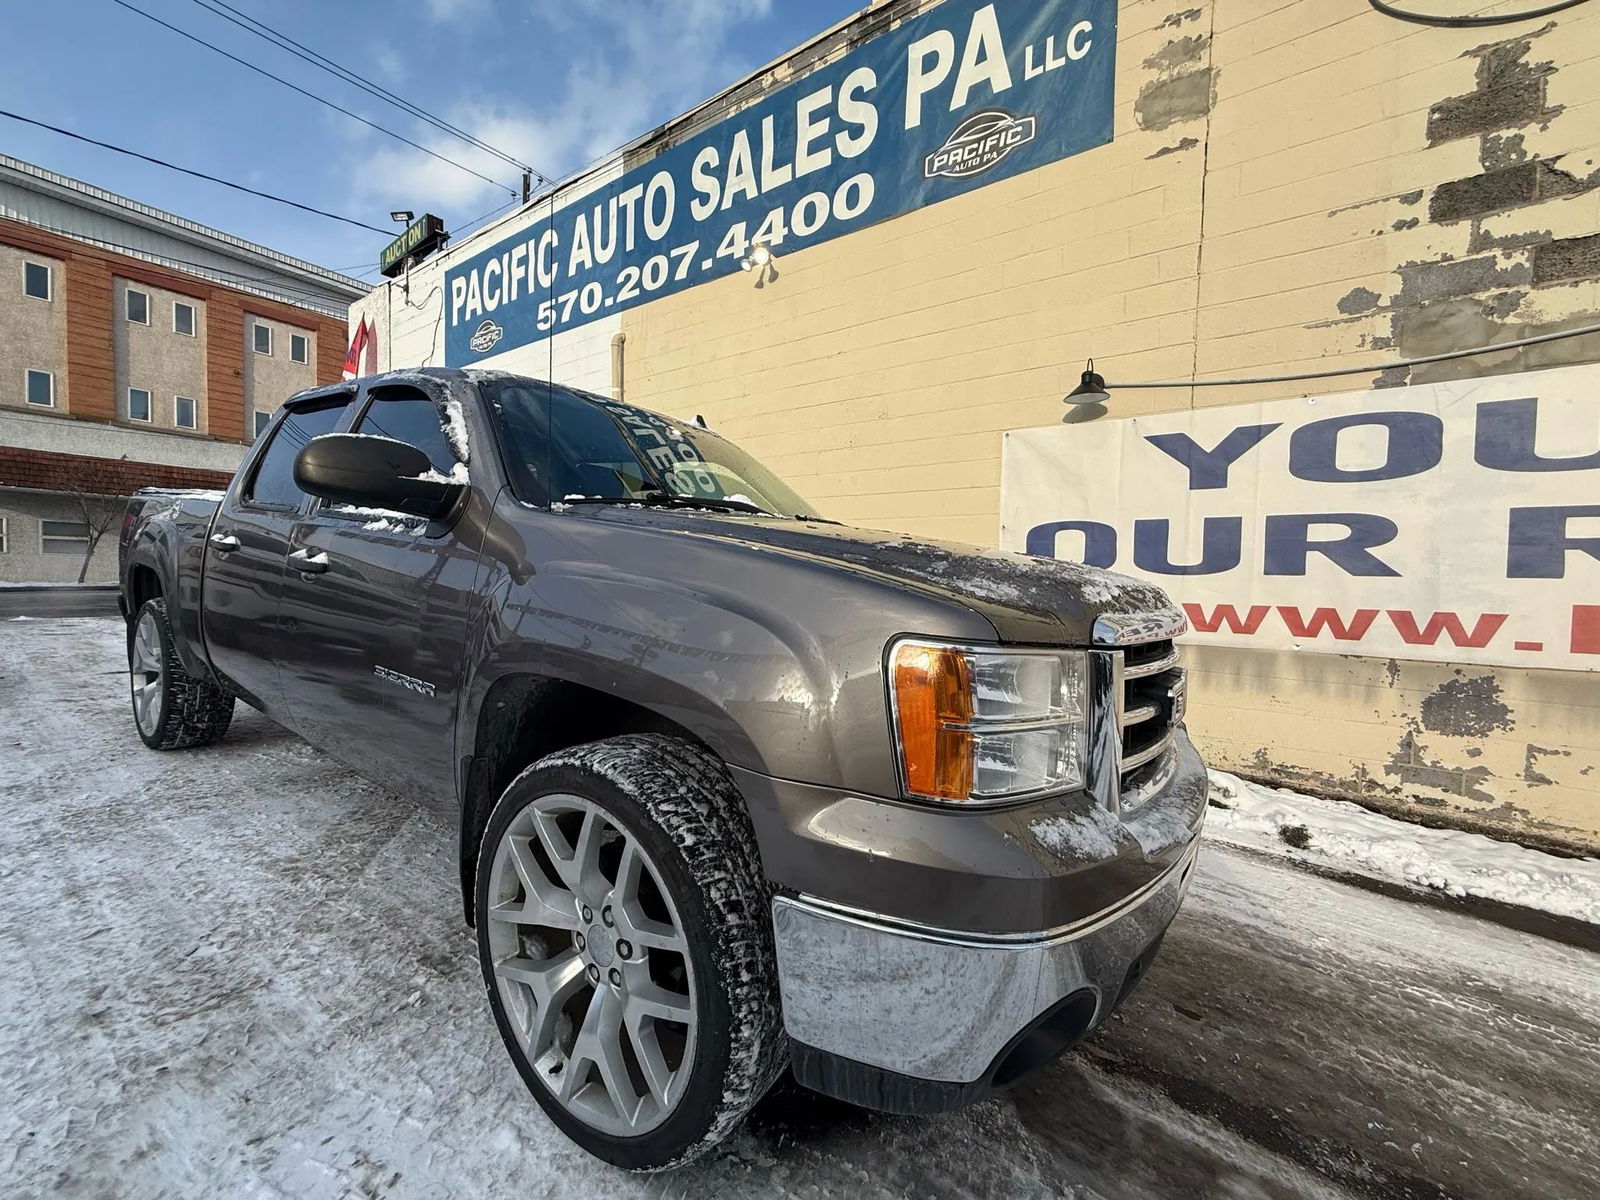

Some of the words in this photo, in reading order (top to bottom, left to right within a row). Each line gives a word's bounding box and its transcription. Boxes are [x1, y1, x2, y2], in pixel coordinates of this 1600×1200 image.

[451, 228, 559, 327] PACIFIC
[568, 171, 676, 277] AUTO
[690, 67, 879, 222] SALES
[904, 3, 1013, 131] PA
[1023, 20, 1093, 81] LLC
[932, 126, 1023, 172] PACIFIC
[952, 157, 980, 173] AUTO
[982, 151, 998, 163] PA
[385, 222, 421, 266] AUCTON
[536, 173, 876, 331] 570.207.4400
[472, 330, 499, 346] PACIFIC
[1026, 512, 1403, 577] OUR
[1181, 602, 1600, 655] WWW.
[374, 664, 436, 698] SIERRA
